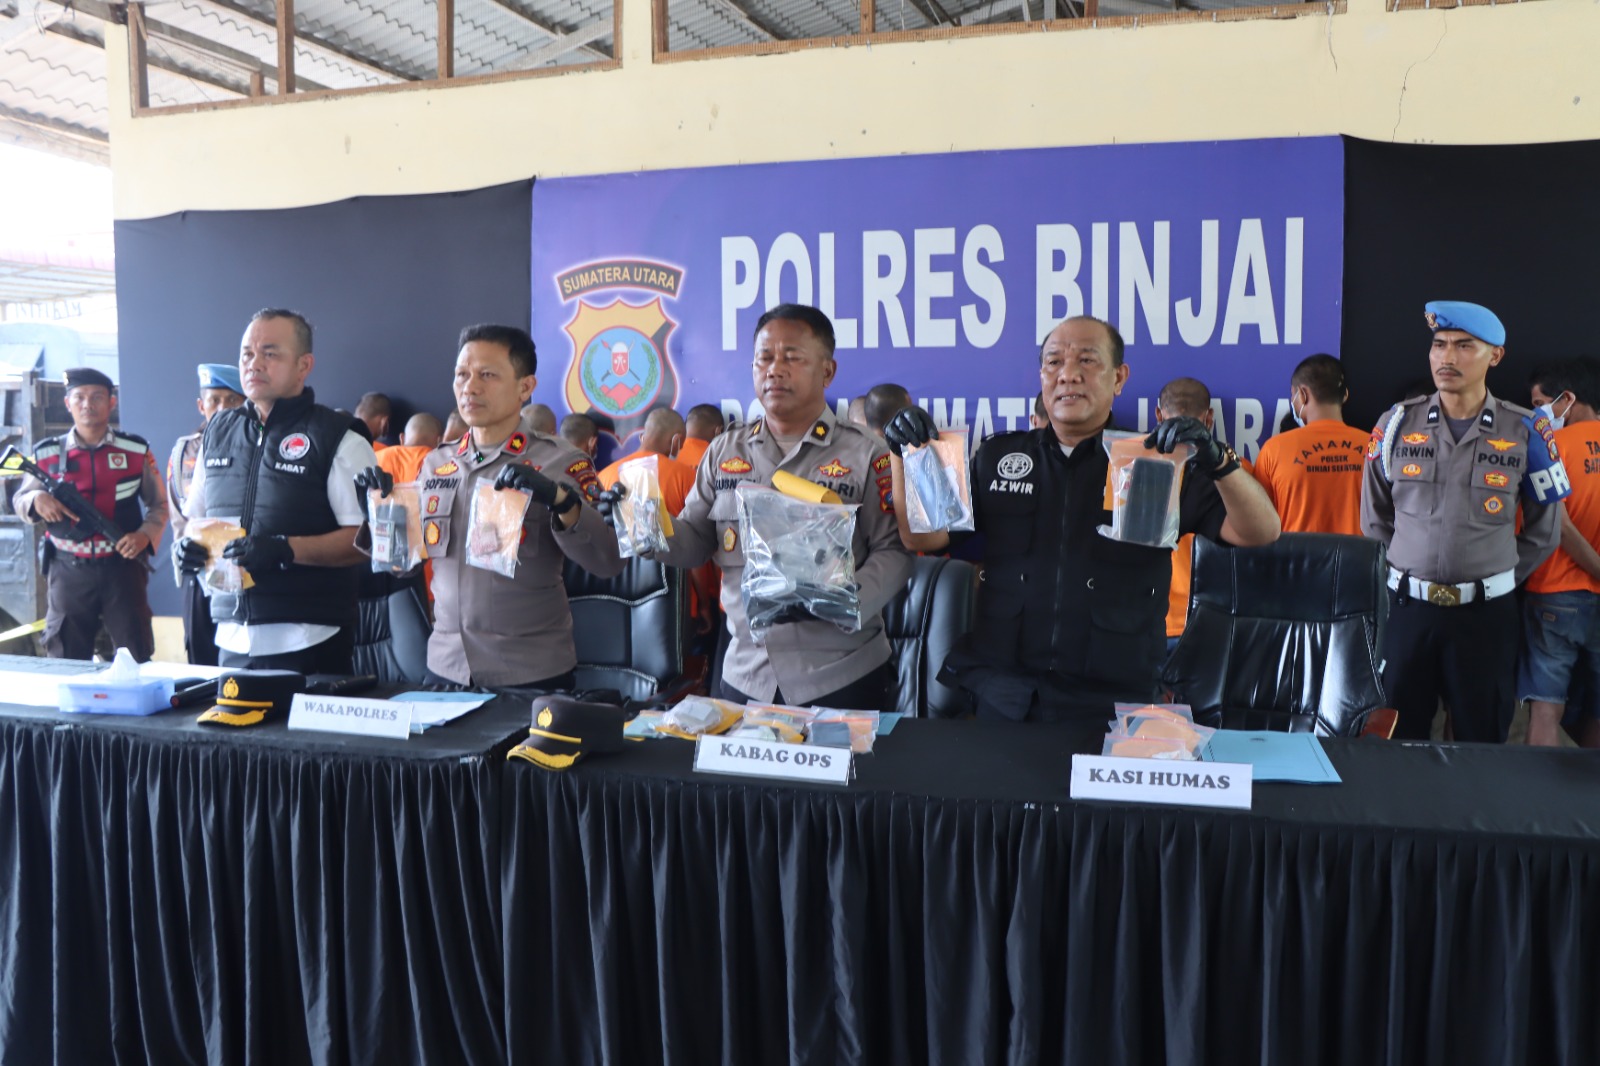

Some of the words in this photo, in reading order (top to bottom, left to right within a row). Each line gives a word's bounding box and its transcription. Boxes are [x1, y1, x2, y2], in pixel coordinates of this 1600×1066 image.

[563, 266, 631, 294] SUMATERA
[633, 266, 676, 291] UTARA
[721, 224, 1006, 351] POLRES
[1035, 217, 1304, 347] BINJAI
[1294, 439, 1367, 465] TAHANA
[1395, 446, 1434, 459] ERWIN
[1478, 453, 1520, 468] POLRI
[989, 479, 1034, 495] AZWIR
[304, 701, 398, 721] WAKAPOLRES
[720, 743, 789, 763] KABAG
[793, 751, 832, 768] OPS
[1089, 768, 1143, 785] KASI
[1149, 771, 1231, 790] HUMAS
